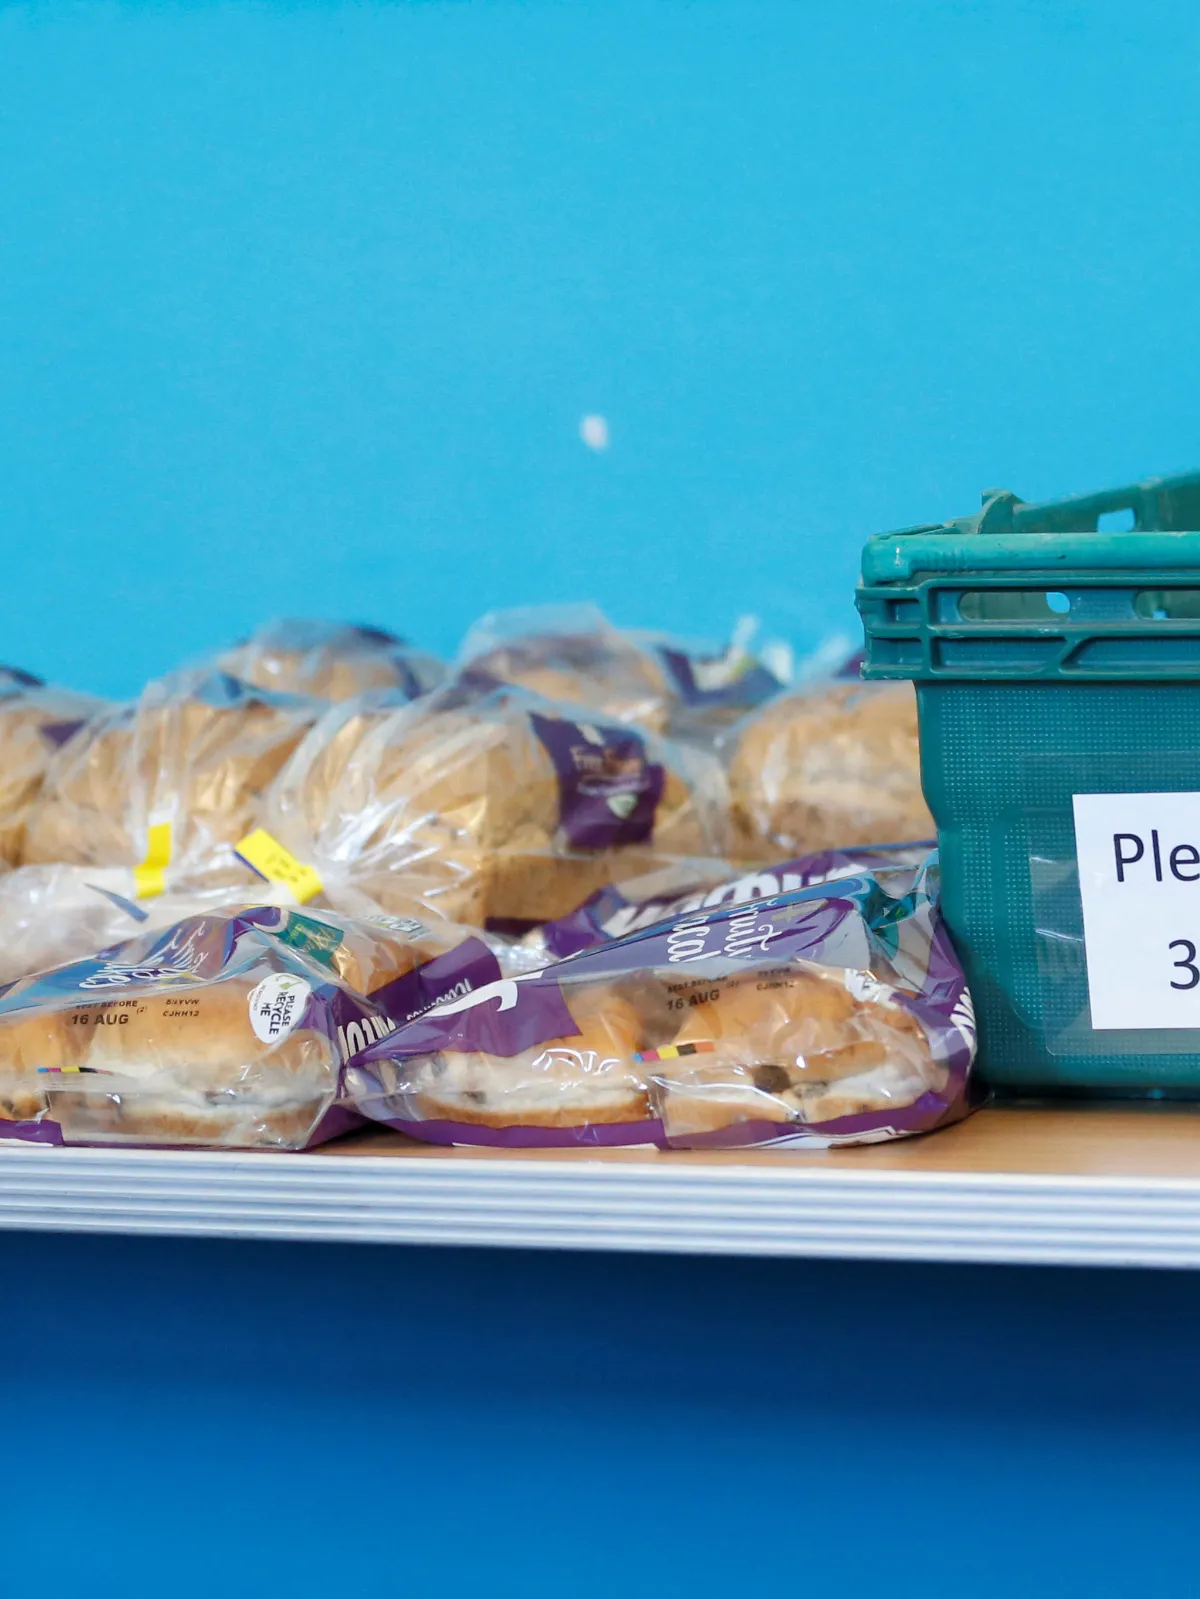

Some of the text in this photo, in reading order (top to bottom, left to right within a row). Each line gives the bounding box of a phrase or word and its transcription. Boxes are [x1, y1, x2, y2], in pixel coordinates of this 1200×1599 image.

[1168, 940, 1200, 990] 3
[101, 1000, 138, 1009] BEFORE
[268, 992, 289, 1035] RECYCLE
[281, 995, 295, 1027] PLEASE
[667, 989, 720, 1011] 16 AUG
[71, 1014, 129, 1026] 16 AUG
